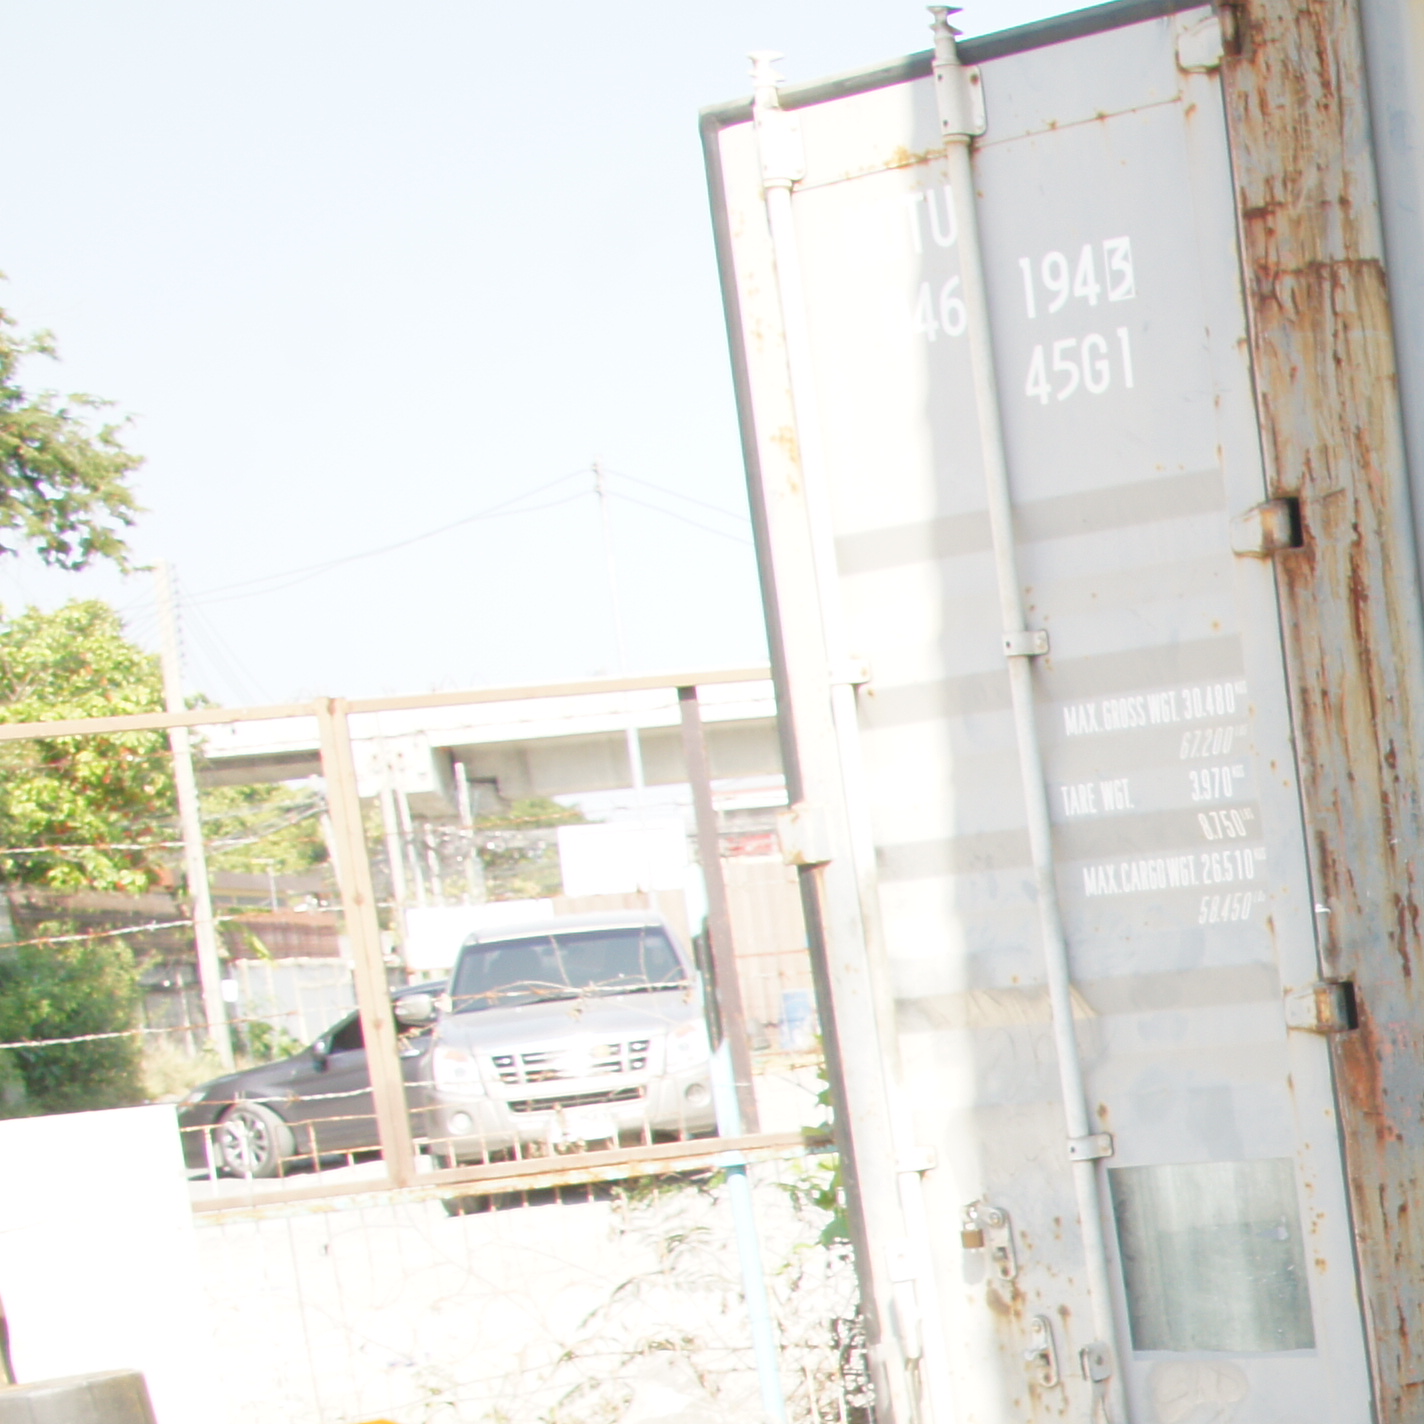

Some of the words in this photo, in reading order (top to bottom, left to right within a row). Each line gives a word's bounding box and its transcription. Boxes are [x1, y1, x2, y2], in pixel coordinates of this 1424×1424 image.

[1018, 236, 1136, 319] 1943
[1024, 326, 1134, 405] 45G1
[1060, 781, 1098, 816] TARE
[1188, 765, 1233, 802] 3.970
[1197, 808, 1248, 841] 8.750
[1200, 848, 1254, 885] 26.510
